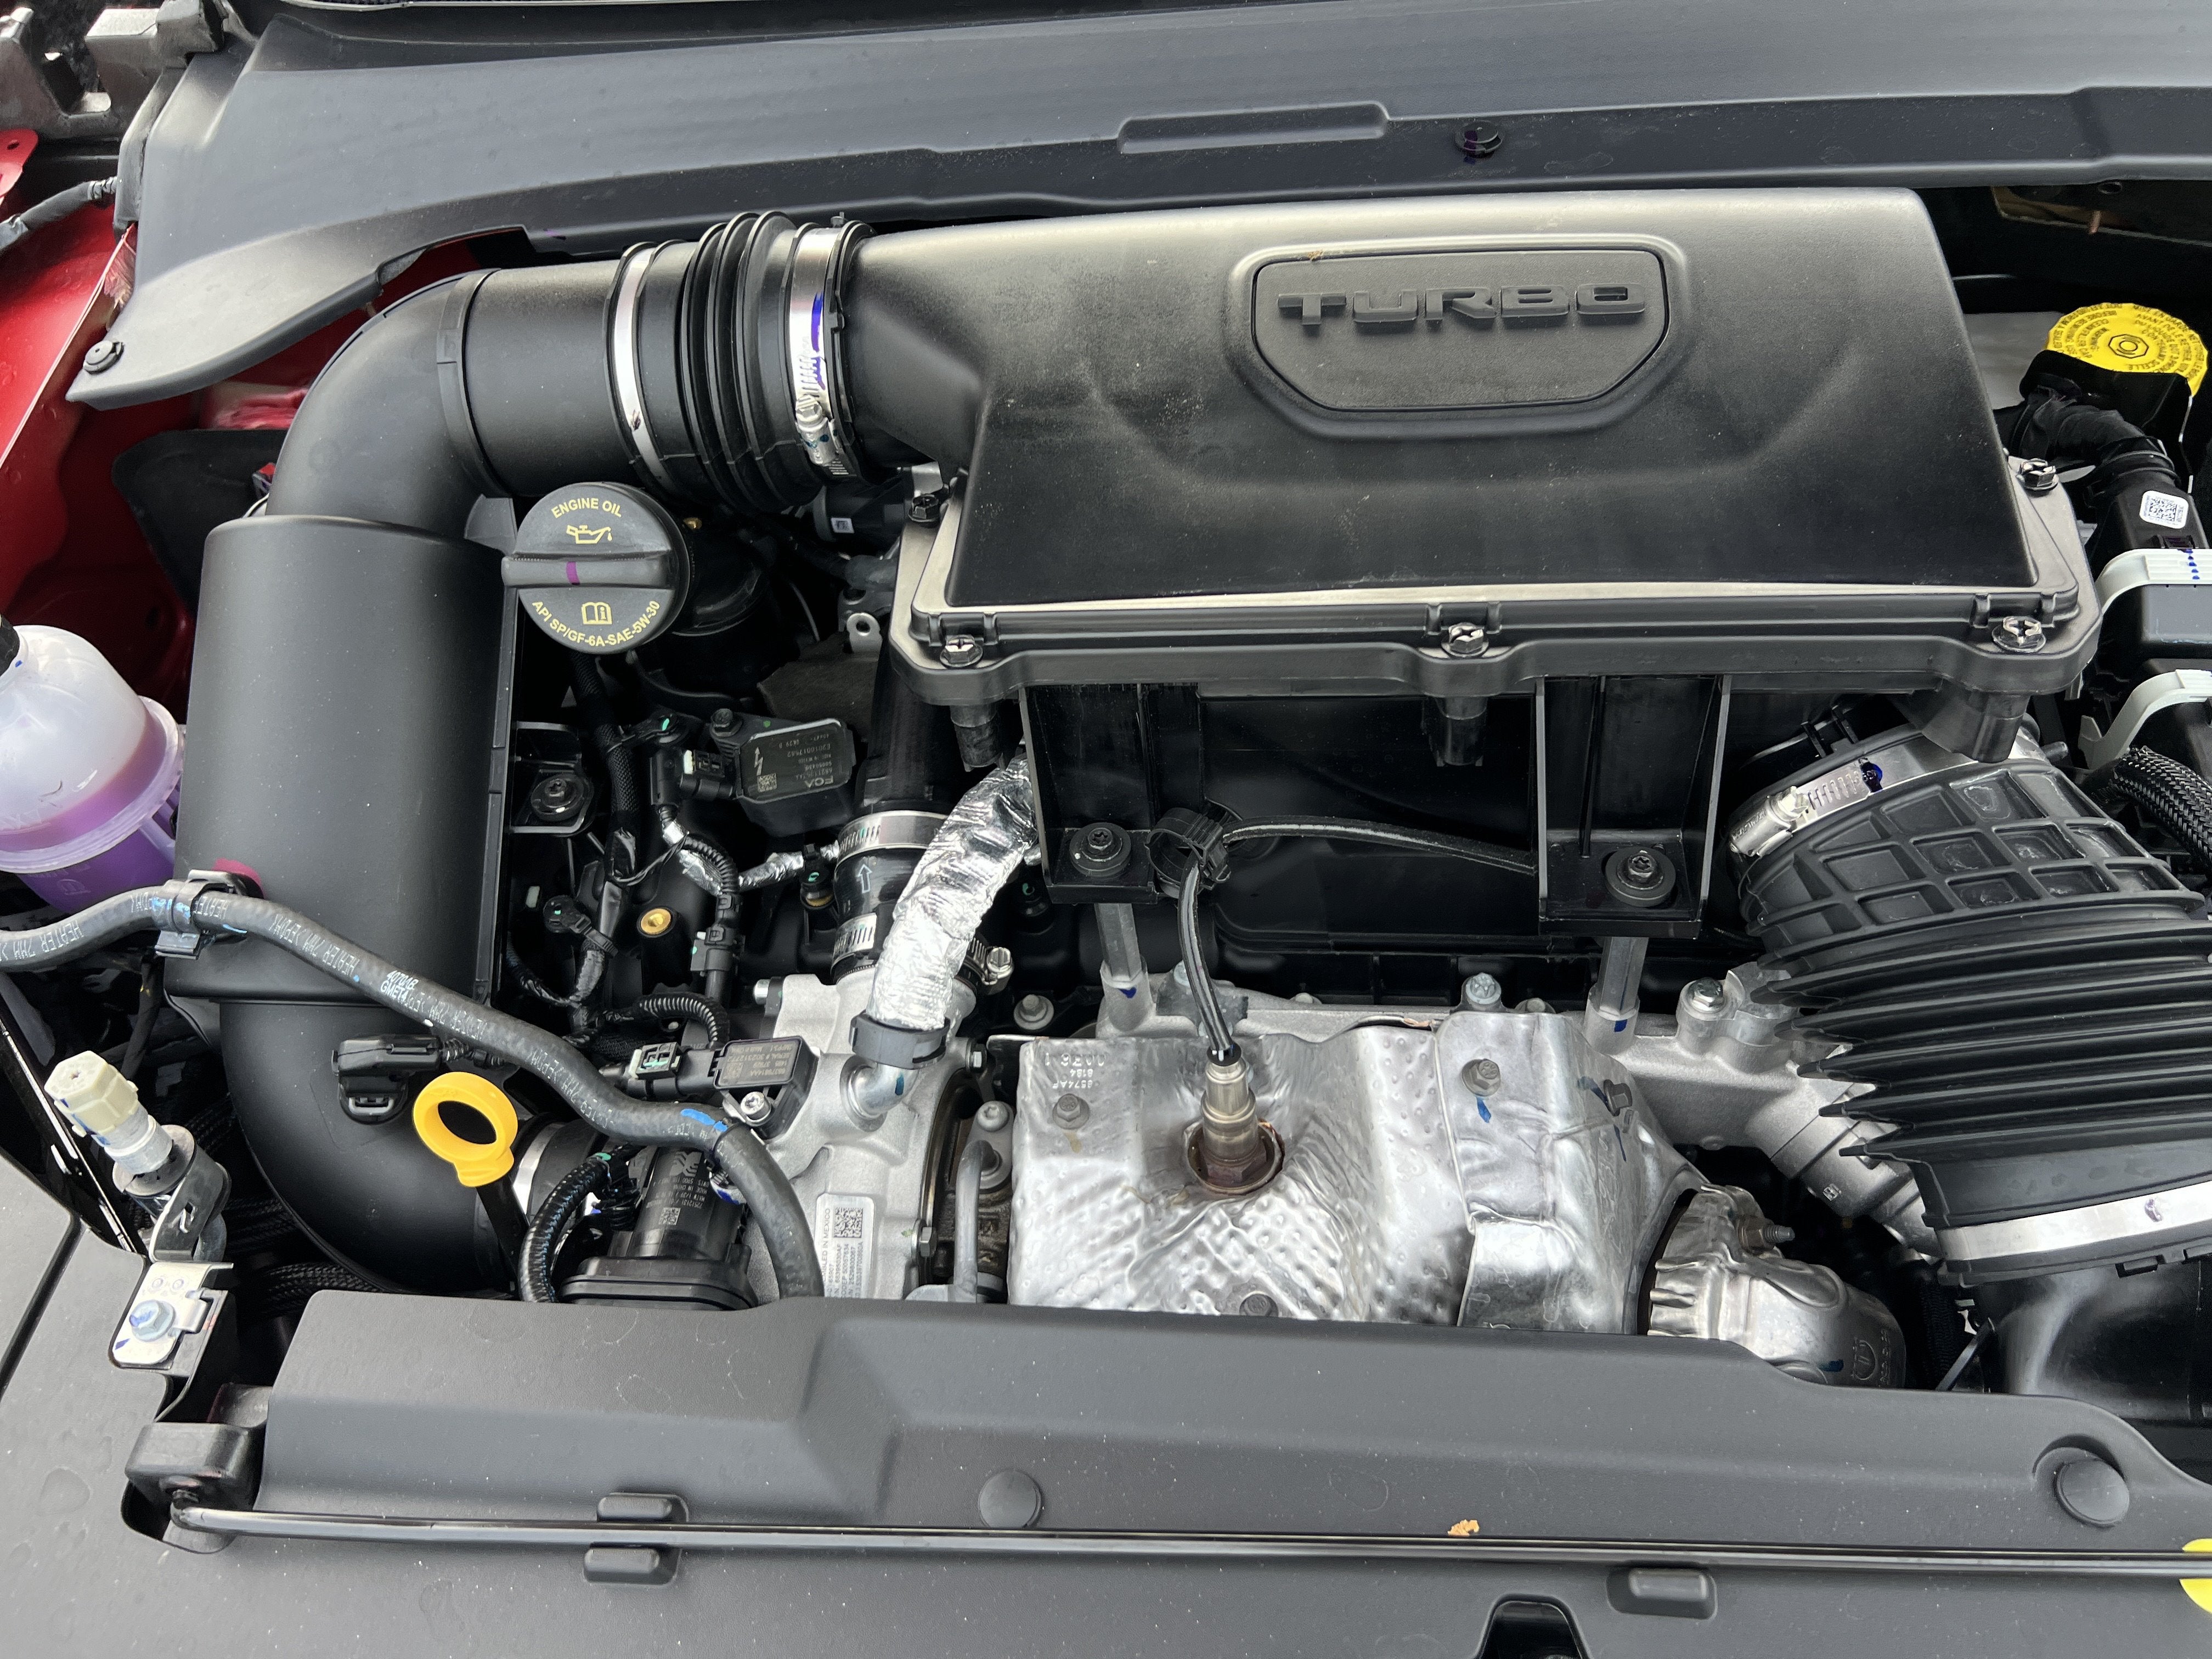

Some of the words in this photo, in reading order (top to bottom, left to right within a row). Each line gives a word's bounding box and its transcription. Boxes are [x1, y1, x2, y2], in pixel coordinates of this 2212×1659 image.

[1278, 283, 1646, 326] TURBO
[551, 498, 599, 518] ENGINE
[602, 500, 622, 517] OIL
[532, 601, 551, 622] API
[804, 775, 834, 788] FCA
[39, 919, 84, 953] HEATER
[322, 944, 360, 977] HEATER
